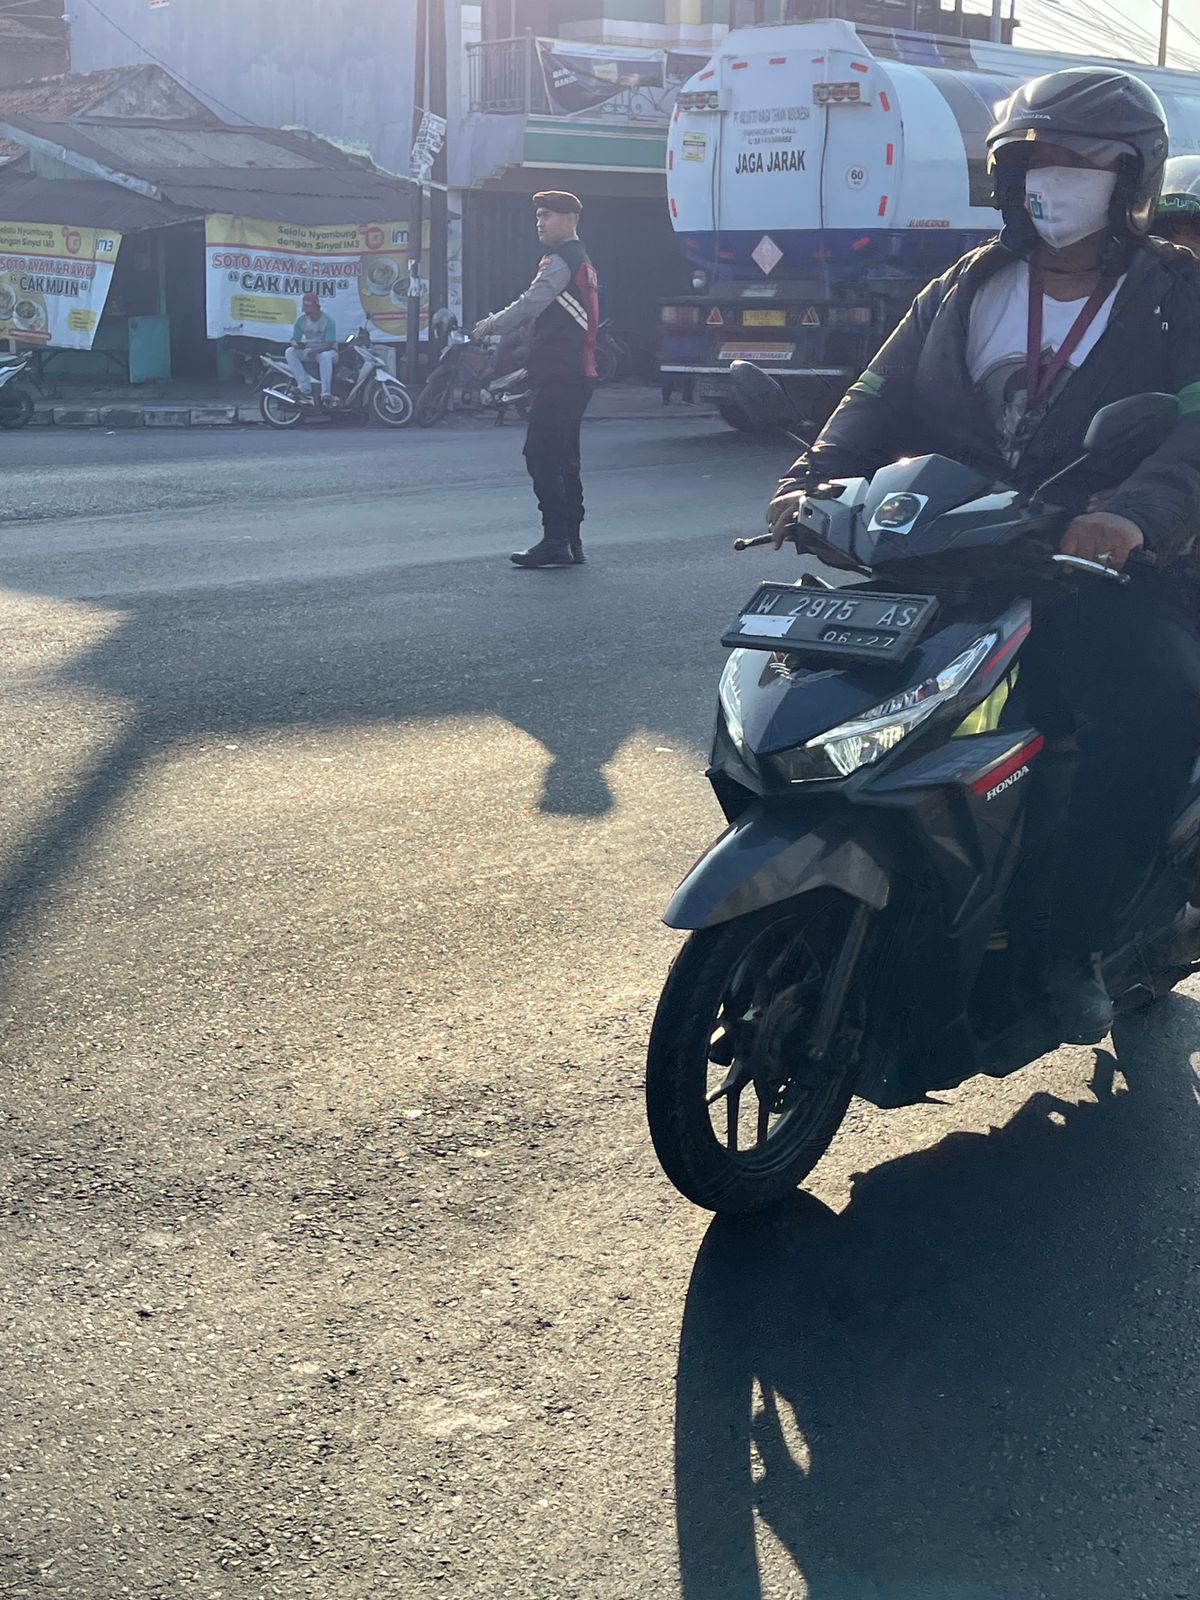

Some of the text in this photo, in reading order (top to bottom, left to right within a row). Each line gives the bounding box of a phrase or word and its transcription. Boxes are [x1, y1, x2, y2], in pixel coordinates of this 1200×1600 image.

[735, 150, 806, 174] JAGA JARAK
[851, 169, 864, 180] 60
[277, 225, 357, 241] Selalu Nyambung
[314, 241, 342, 251] Sinyal
[343, 240, 360, 249] IM3
[0, 257, 26, 271] SOTO
[28, 261, 54, 274] AYAM
[61, 263, 95, 278] RAWO
[212, 253, 363, 277] SOTO AYAM & RAWON
[756, 594, 918, 627] W 2975 AS
[985, 765, 1030, 801] HONDA
